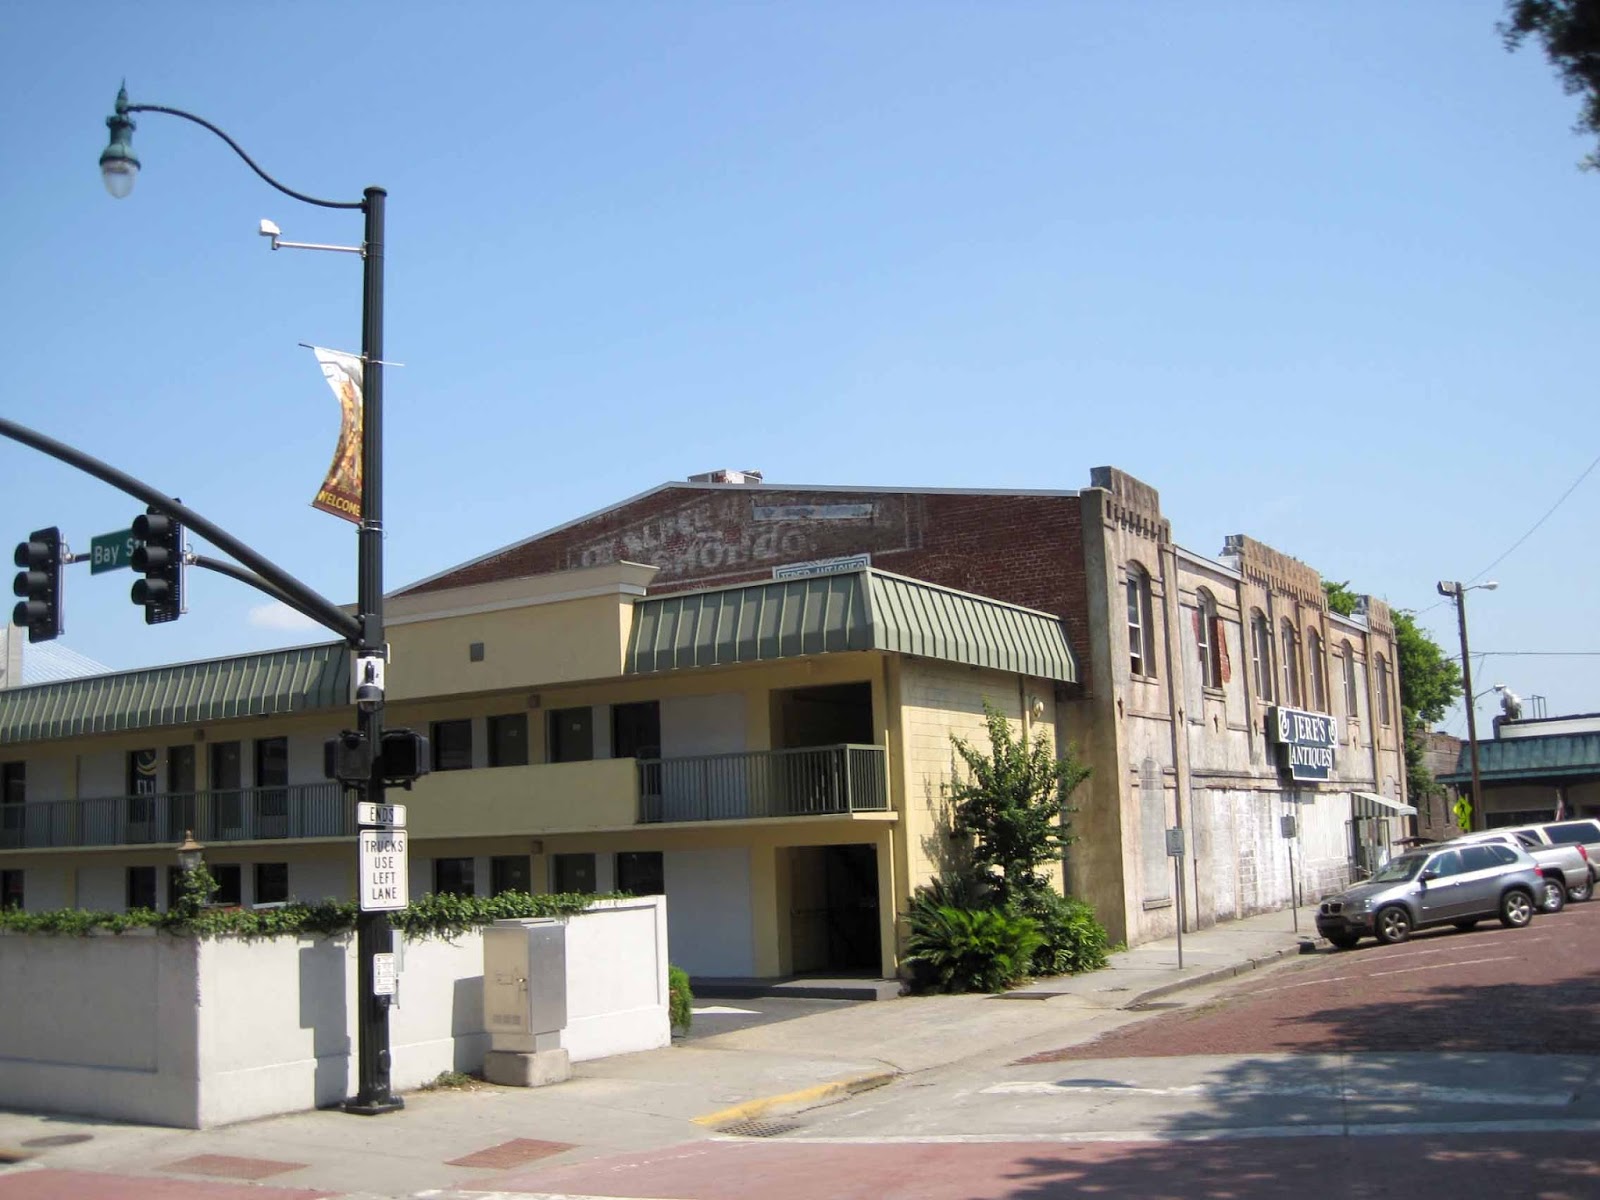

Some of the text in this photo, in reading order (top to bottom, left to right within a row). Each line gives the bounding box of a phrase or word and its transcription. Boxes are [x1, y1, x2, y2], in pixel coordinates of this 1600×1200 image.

[318, 491, 361, 517] WELCOME
[94, 545, 120, 565] Bay
[1293, 714, 1326, 743] JERE'S
[1291, 745, 1331, 769] ANTIQUES
[369, 806, 394, 822] ENDS
[365, 840, 404, 853] TRUCKS
[374, 856, 394, 869] USE
[373, 872, 395, 885] LEFT
[372, 887, 397, 900] LANE
